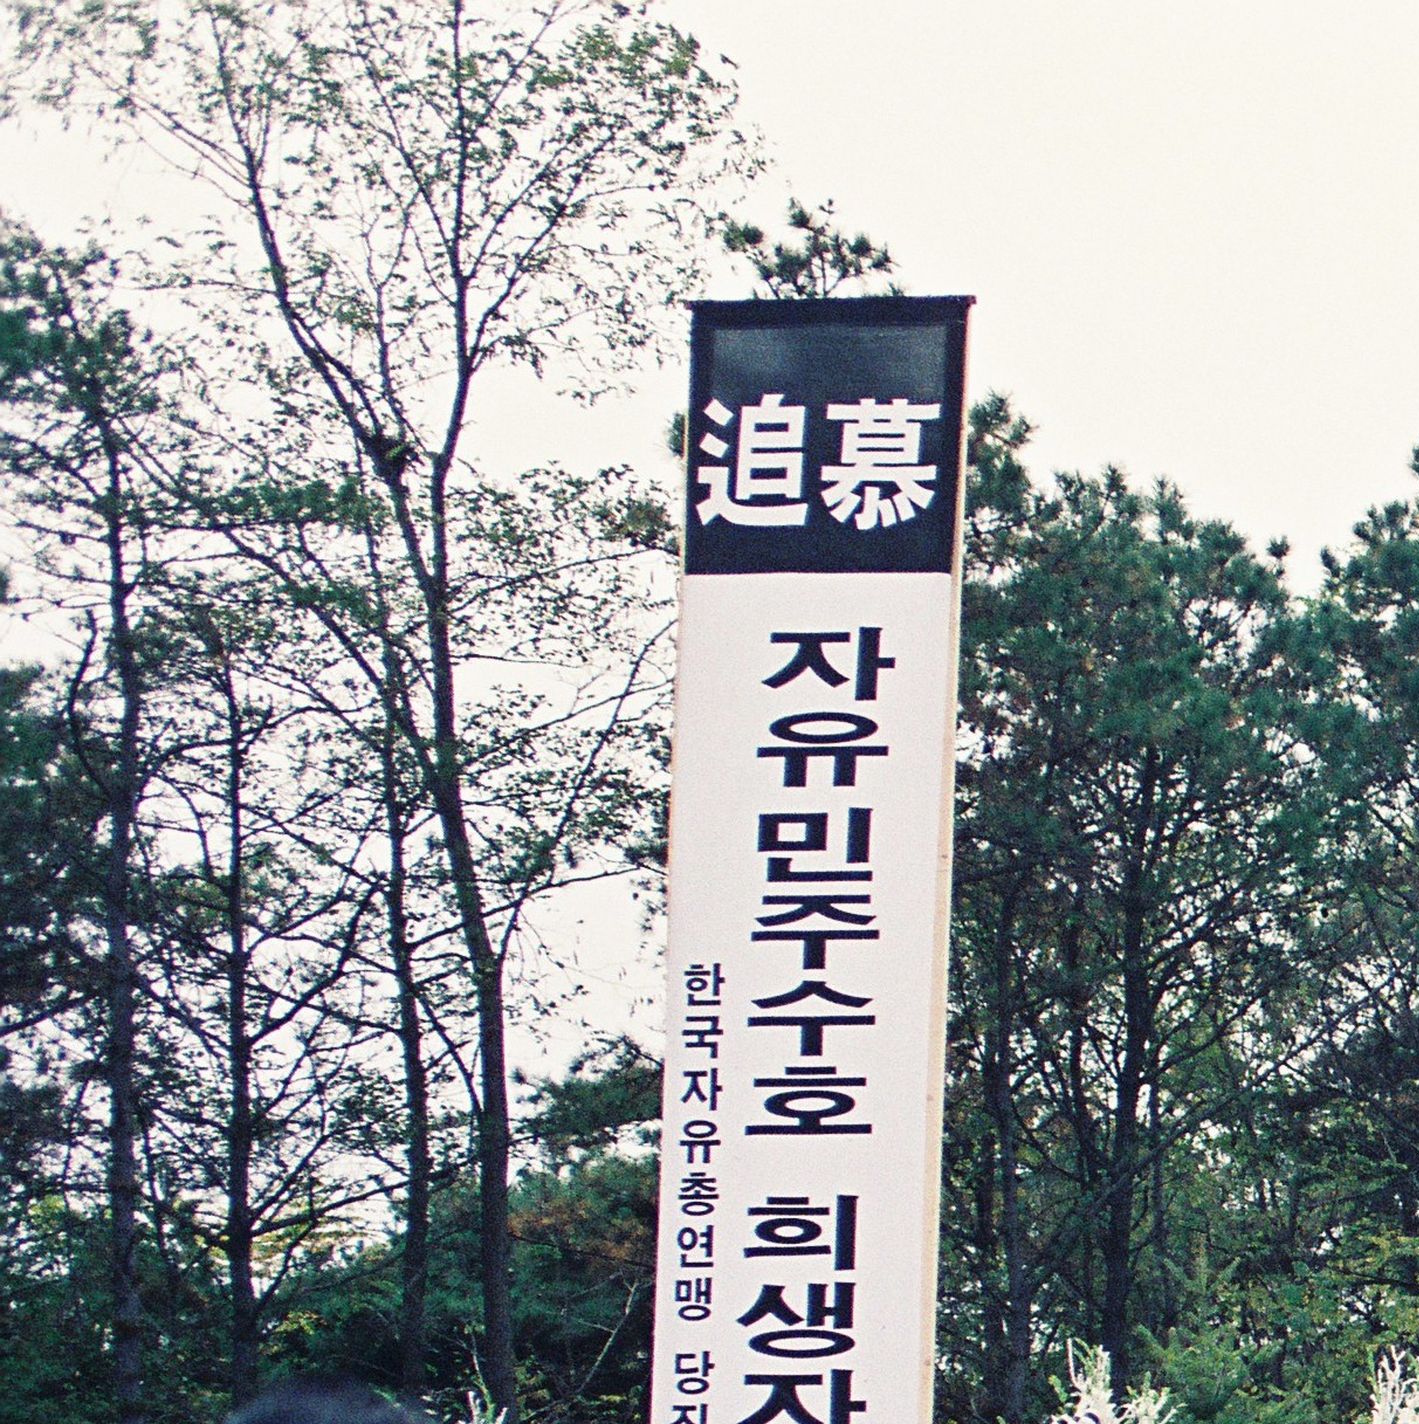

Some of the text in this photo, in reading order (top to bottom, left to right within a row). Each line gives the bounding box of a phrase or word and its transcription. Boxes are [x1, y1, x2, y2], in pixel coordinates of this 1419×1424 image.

[697, 394, 942, 532] 追慕
[746, 627, 897, 1136] 자유민주수호
[675, 963, 726, 1322] 한국자유총연맹
